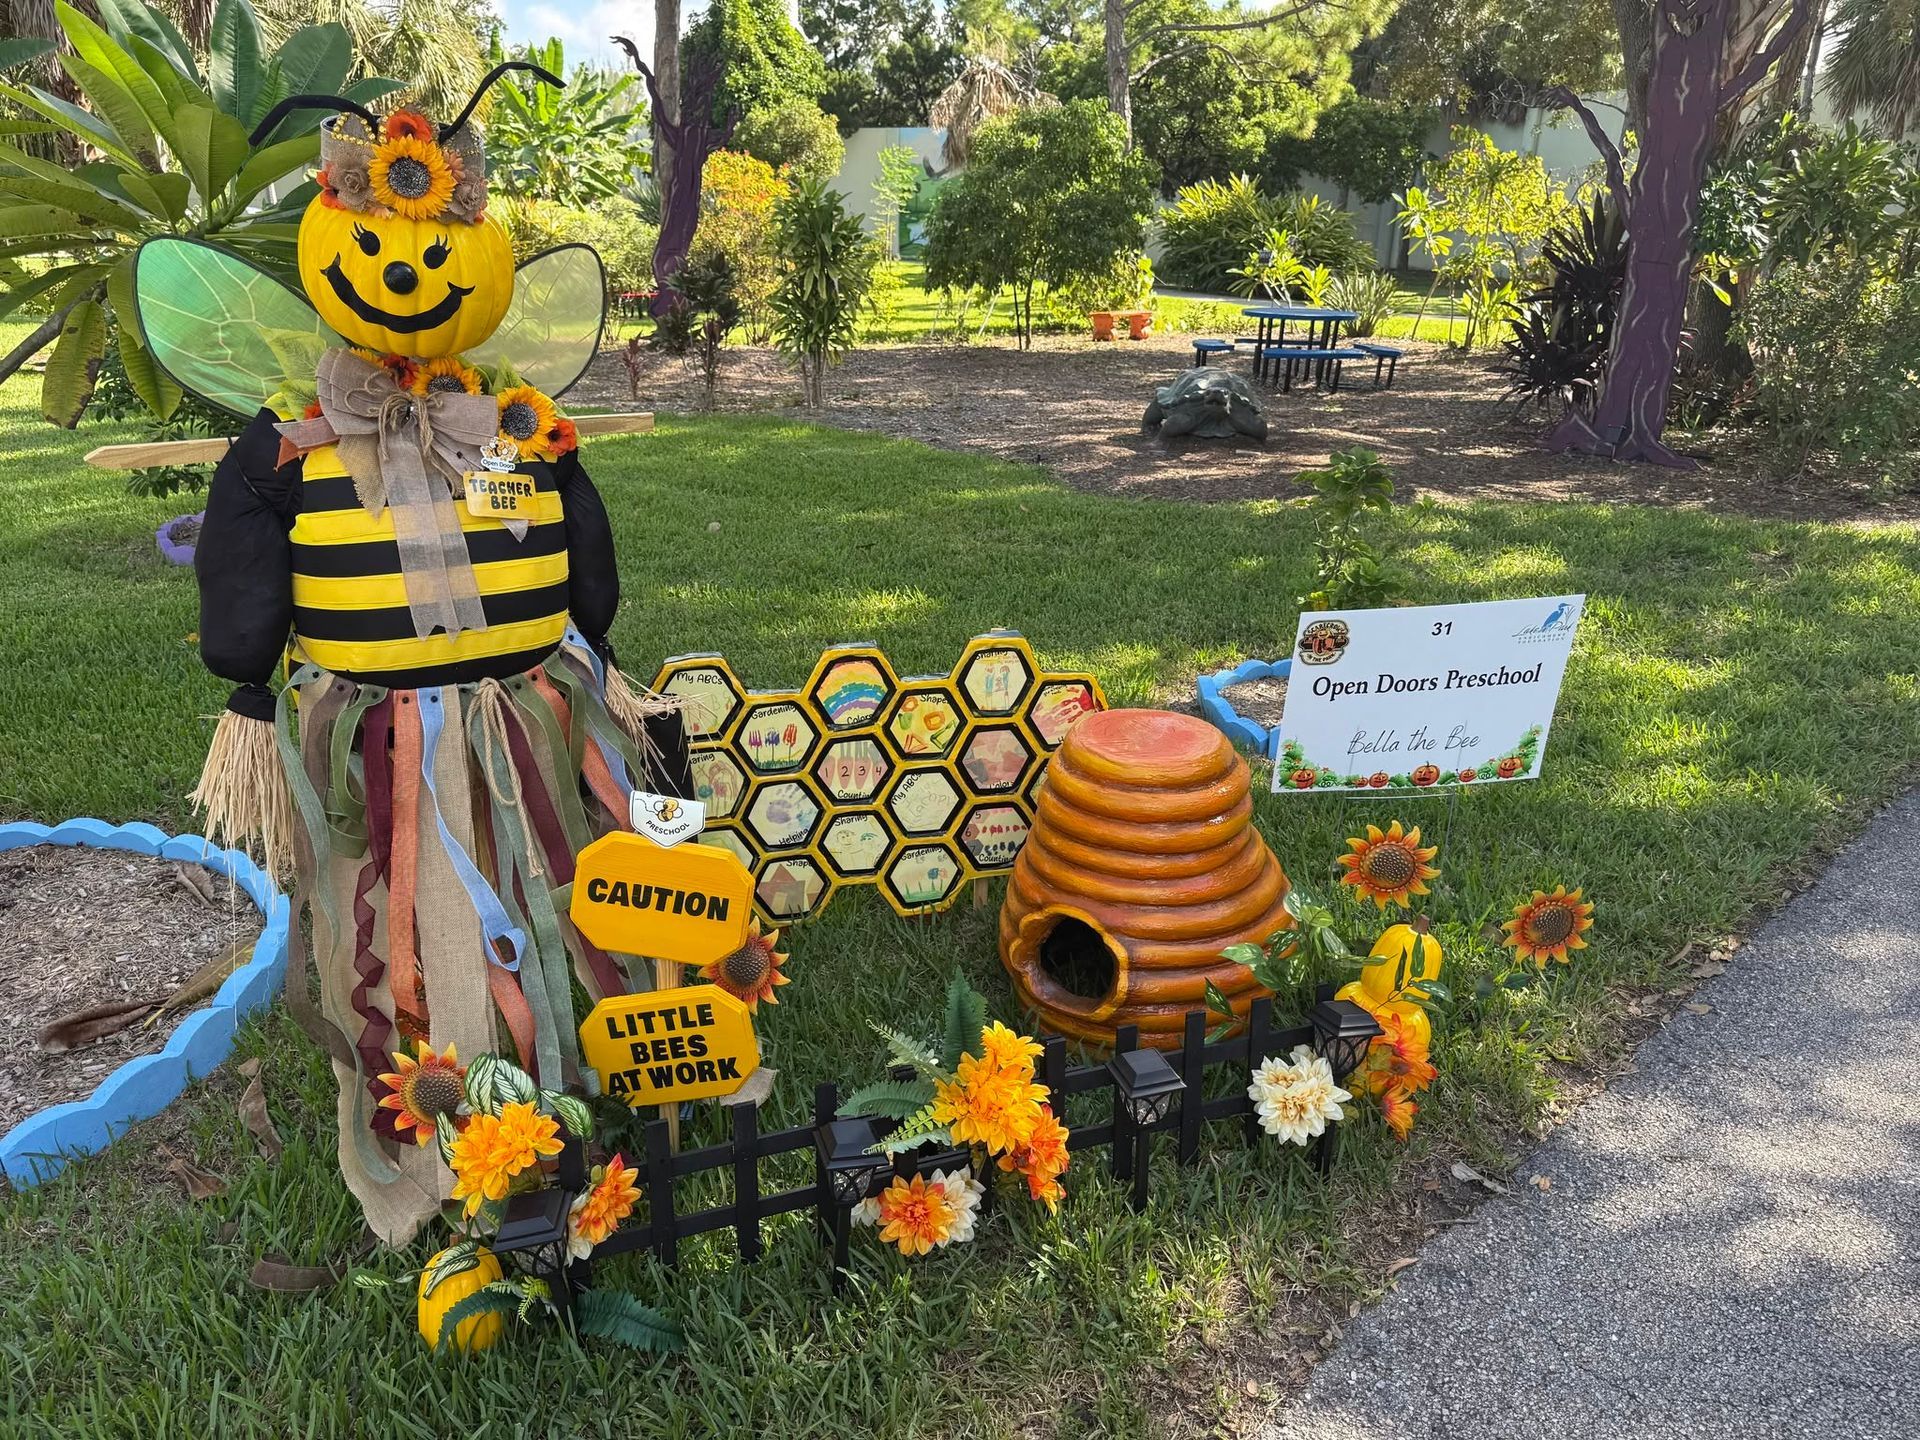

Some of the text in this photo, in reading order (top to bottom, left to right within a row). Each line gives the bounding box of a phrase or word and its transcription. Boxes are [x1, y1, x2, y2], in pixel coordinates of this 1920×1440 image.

[469, 479, 532, 497] TEACHER
[490, 495, 517, 510] BEE
[1431, 621, 1452, 636] 31
[676, 672, 723, 685] My ABCs
[1312, 663, 1543, 701] Open Doors Preschool
[920, 694, 950, 705] Shape
[751, 704, 797, 719] Gardening
[1347, 724, 1481, 755] Bella the Bee
[689, 753, 715, 765] aring
[841, 765, 849, 777] 2
[858, 765, 866, 776] 3
[876, 766, 882, 776] 4
[837, 789, 871, 799] Countin
[891, 790, 906, 806] My
[835, 814, 868, 826] Sharing
[975, 811, 982, 819] 5
[645, 820, 690, 835] PRESCHOOL
[965, 827, 972, 837] 6
[901, 847, 943, 861] Gardening
[786, 860, 812, 868] Shap
[587, 877, 730, 922] CAUTION
[605, 1003, 715, 1040] LITTLE
[629, 1034, 708, 1065] BEES
[607, 1057, 742, 1096] AT WORK
